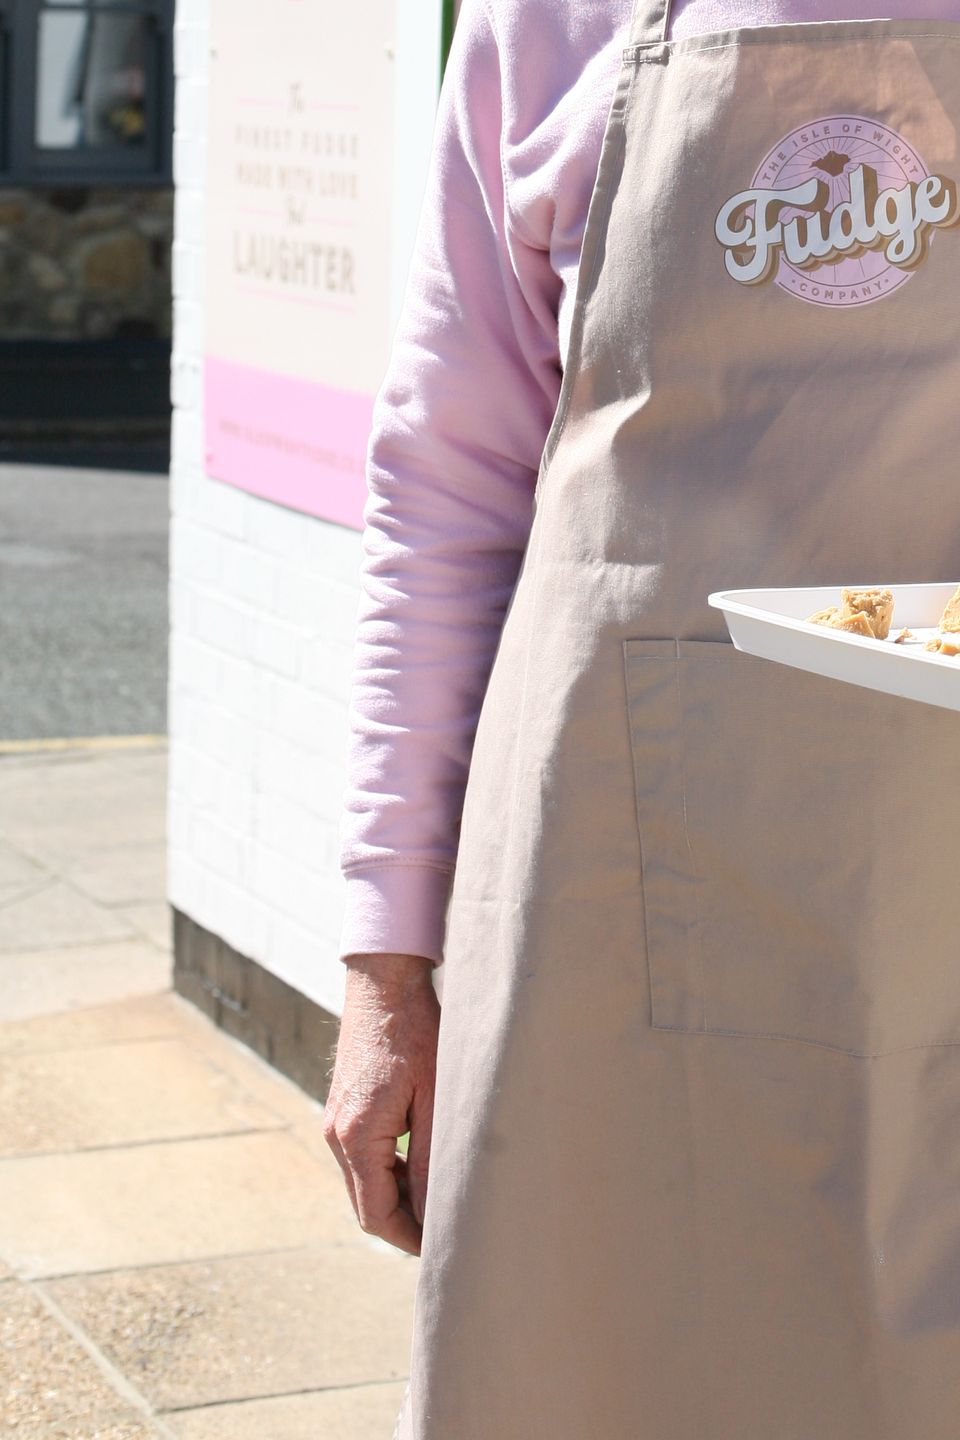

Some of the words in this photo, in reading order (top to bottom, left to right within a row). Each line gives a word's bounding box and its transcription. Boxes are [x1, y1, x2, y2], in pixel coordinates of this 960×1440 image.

[762, 151, 787, 182] THE
[792, 124, 831, 148] ISLE
[841, 123, 863, 136] OF
[872, 129, 919, 175] WIGHT
[232, 228, 357, 296] LAUGHTER
[799, 279, 883, 301] COMPANY
